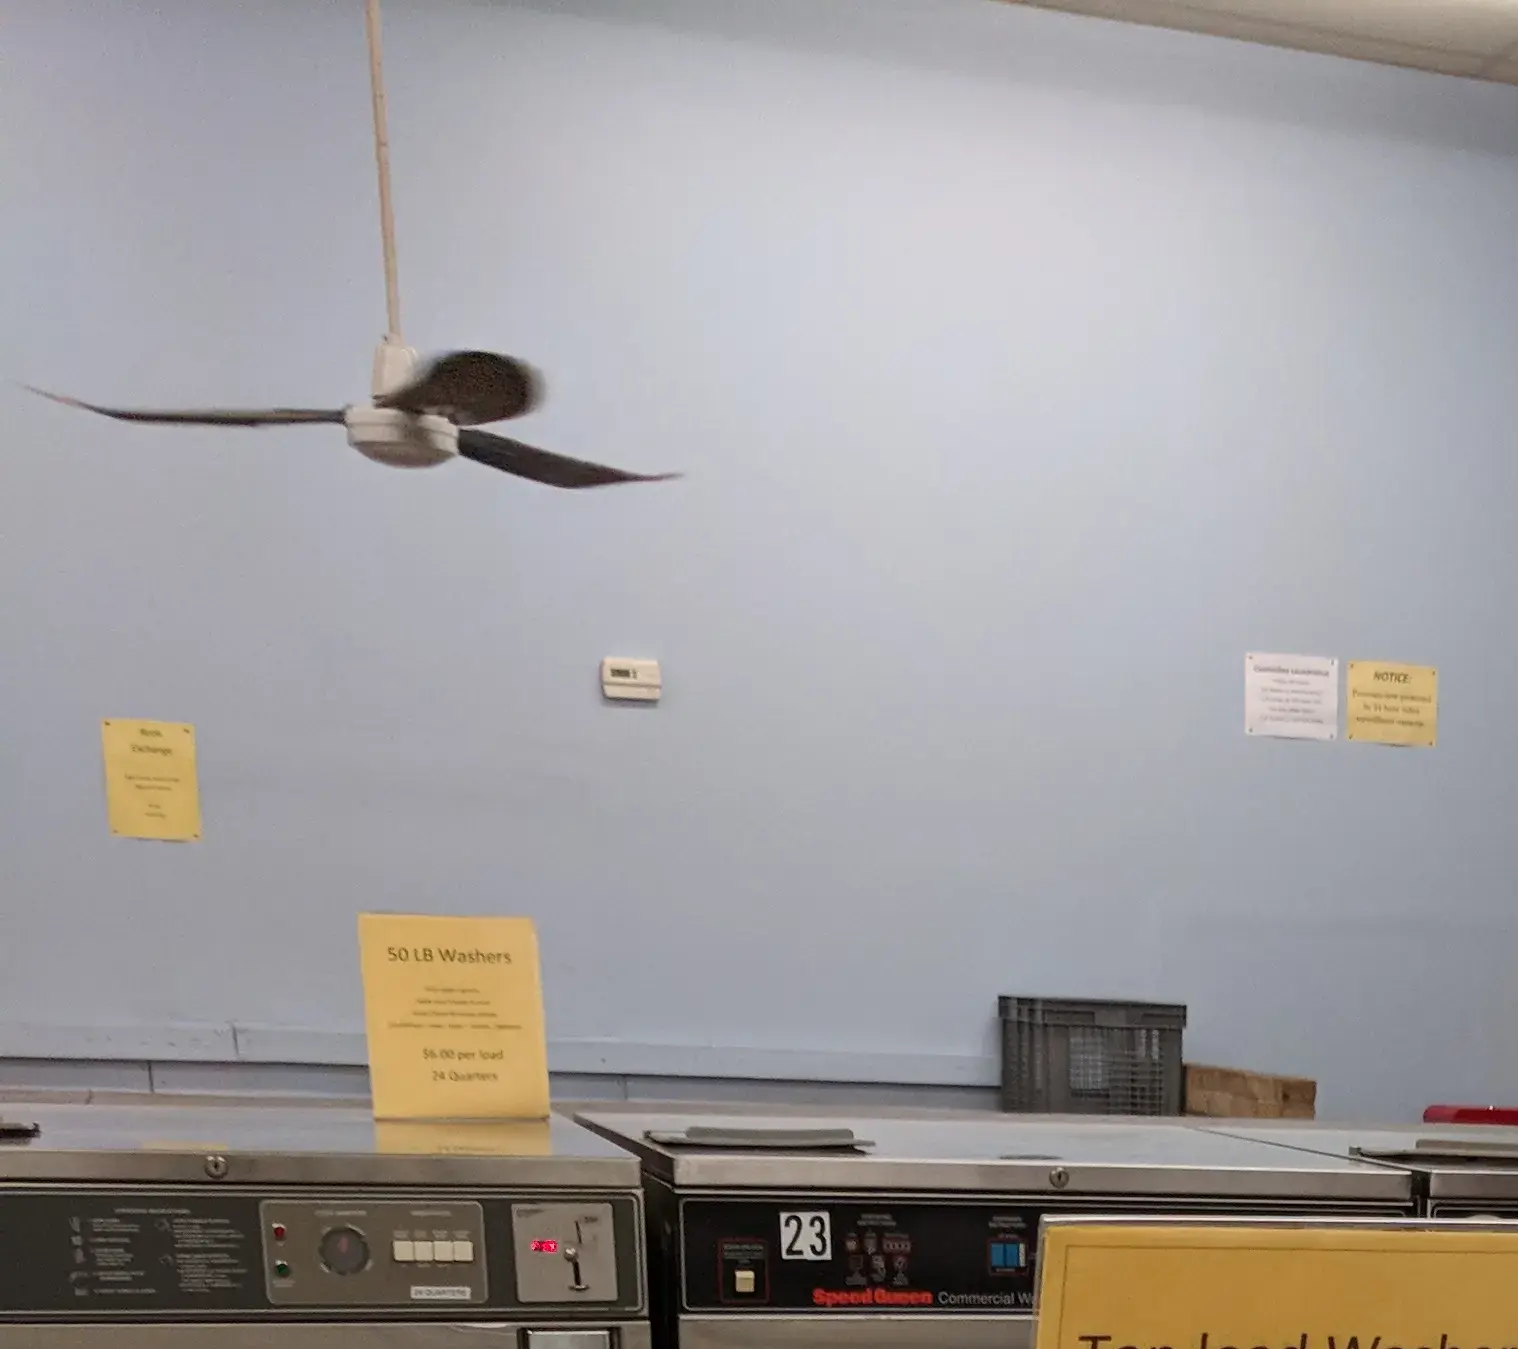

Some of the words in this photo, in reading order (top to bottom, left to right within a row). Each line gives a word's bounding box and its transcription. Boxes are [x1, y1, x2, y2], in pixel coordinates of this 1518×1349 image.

[387, 947, 409, 963] 50
[414, 948, 434, 962] LB
[437, 948, 513, 965] Washers
[457, 1050, 476, 1061] per
[479, 1049, 504, 1061] load
[449, 1071, 499, 1083] Quarters
[784, 1215, 827, 1256] 23
[812, 1288, 873, 1307] Speed
[873, 1288, 934, 1305] Queen
[938, 1291, 1015, 1306] Commercial
